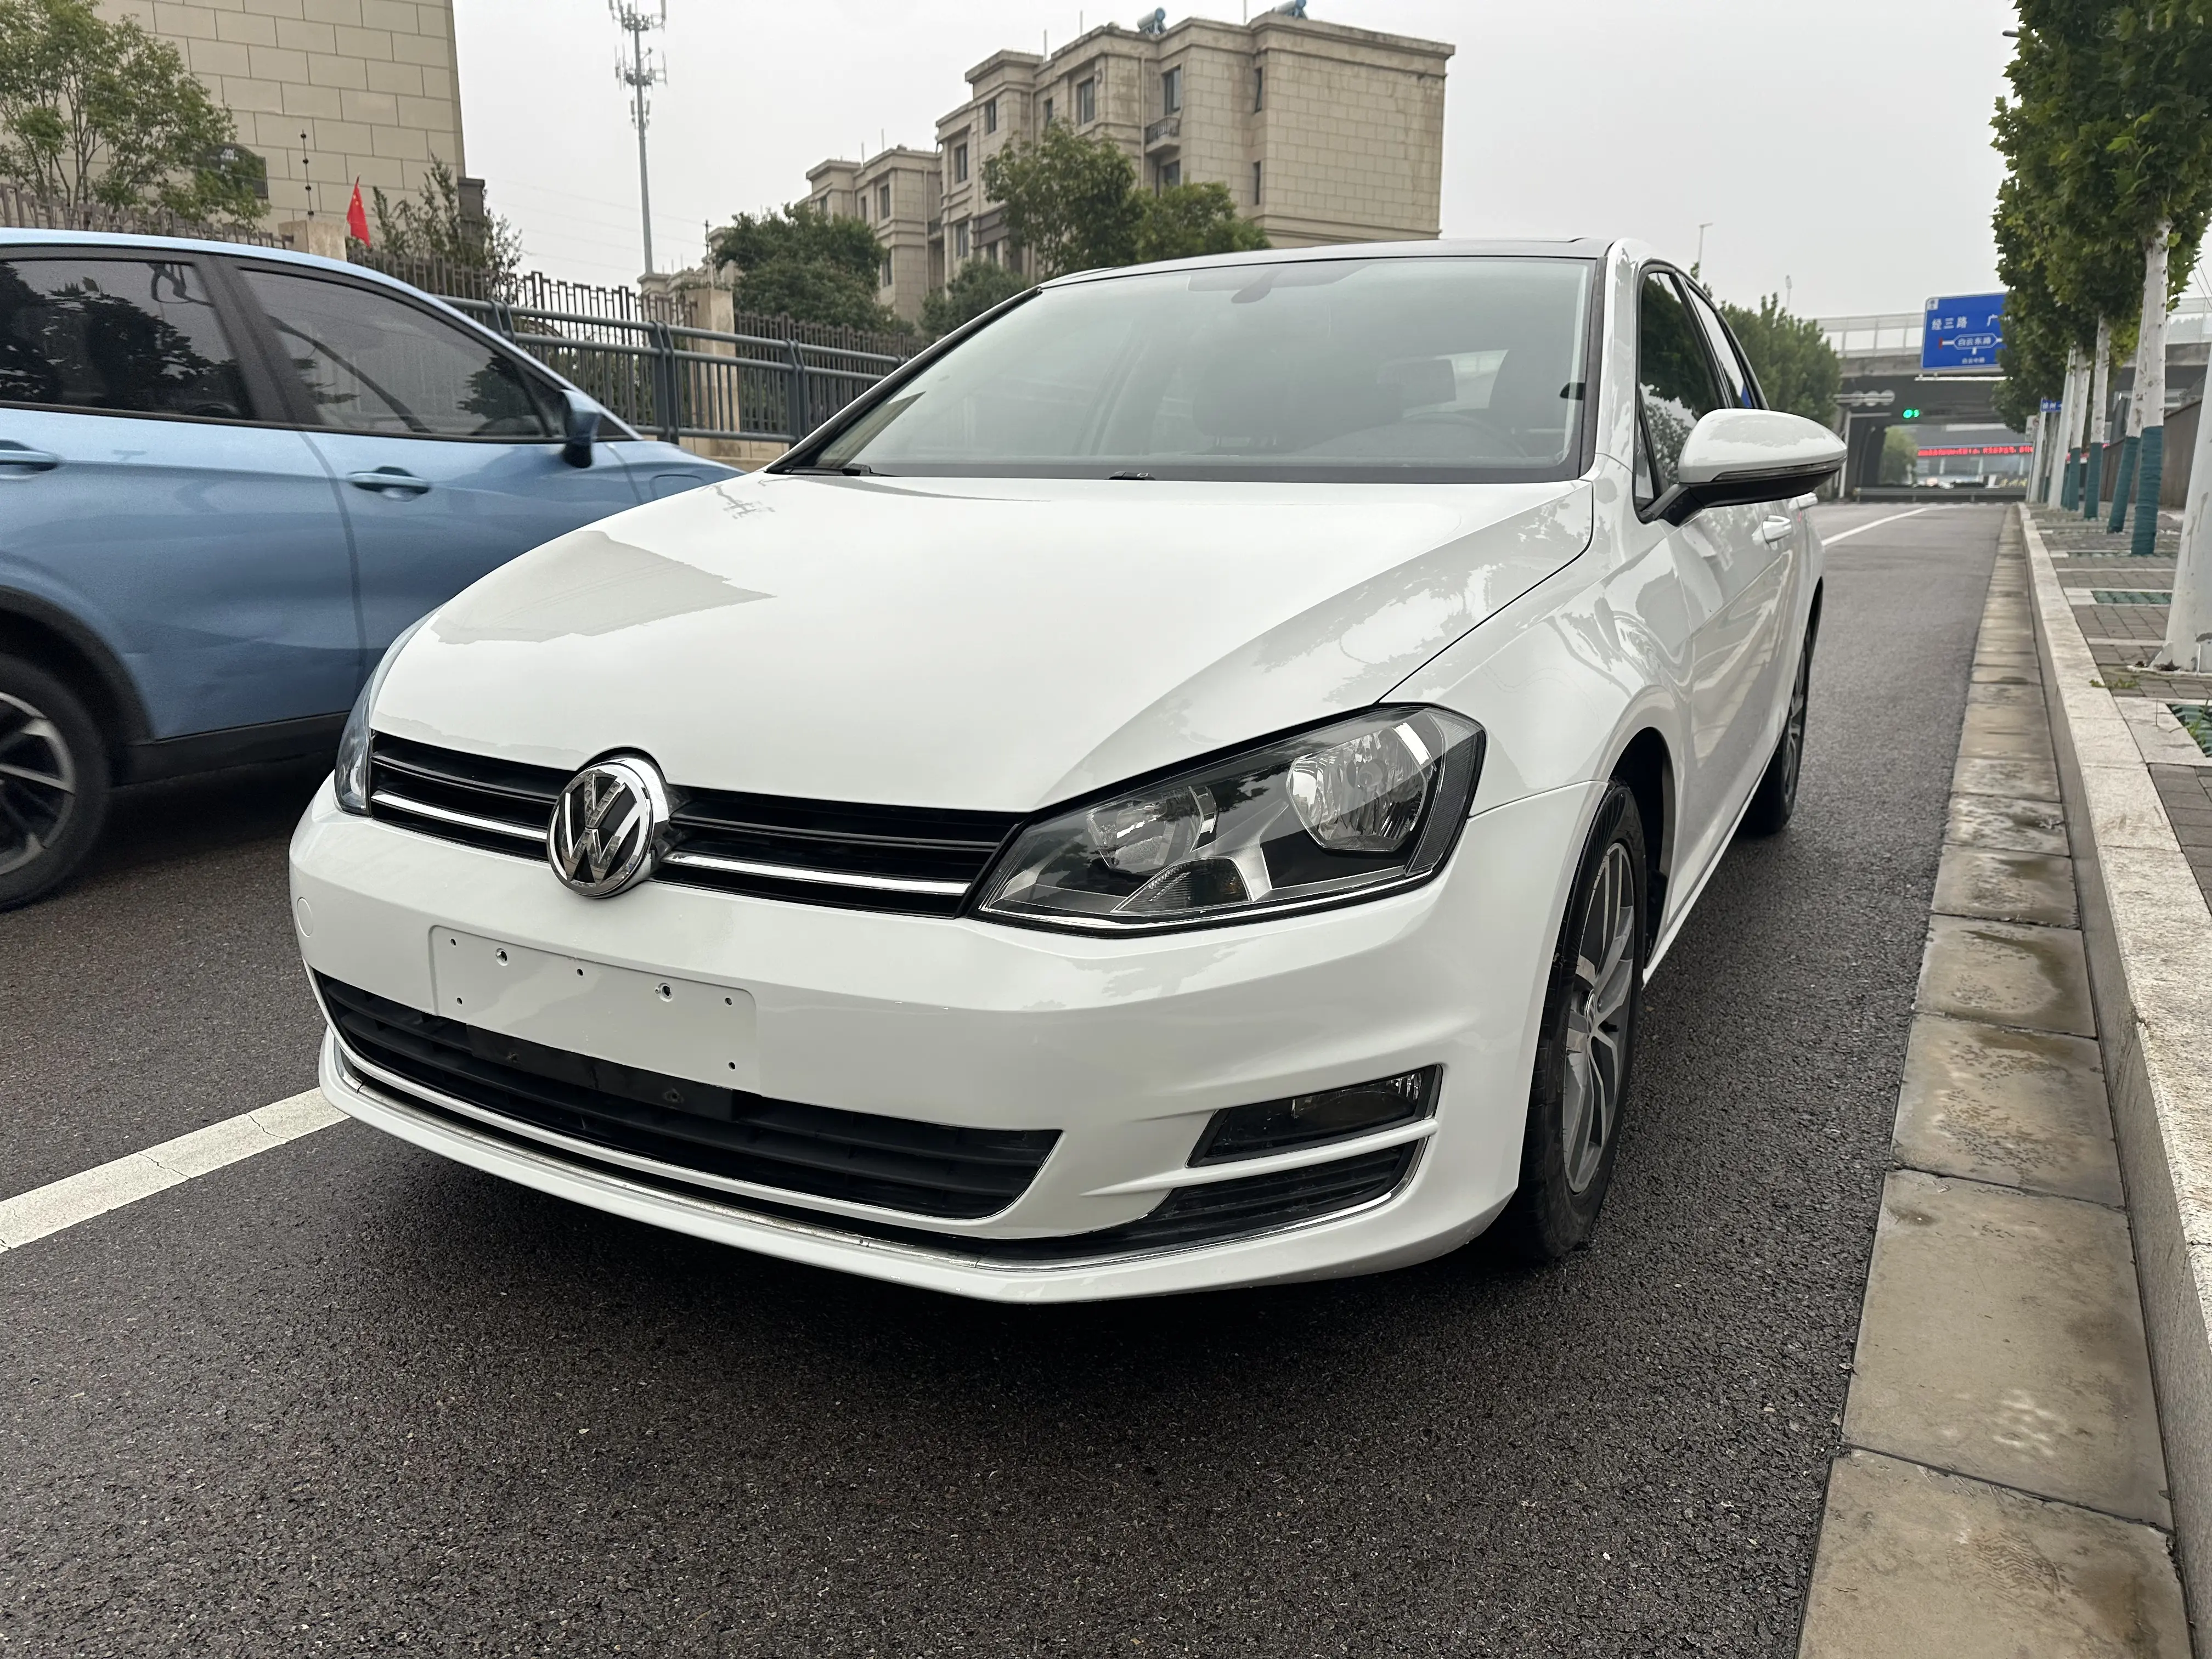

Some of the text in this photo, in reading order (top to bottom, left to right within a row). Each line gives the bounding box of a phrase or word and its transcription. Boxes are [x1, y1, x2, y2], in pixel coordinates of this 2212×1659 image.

[1931, 315, 1967, 330] 经三路
[1957, 336, 1991, 347] 白云东路
